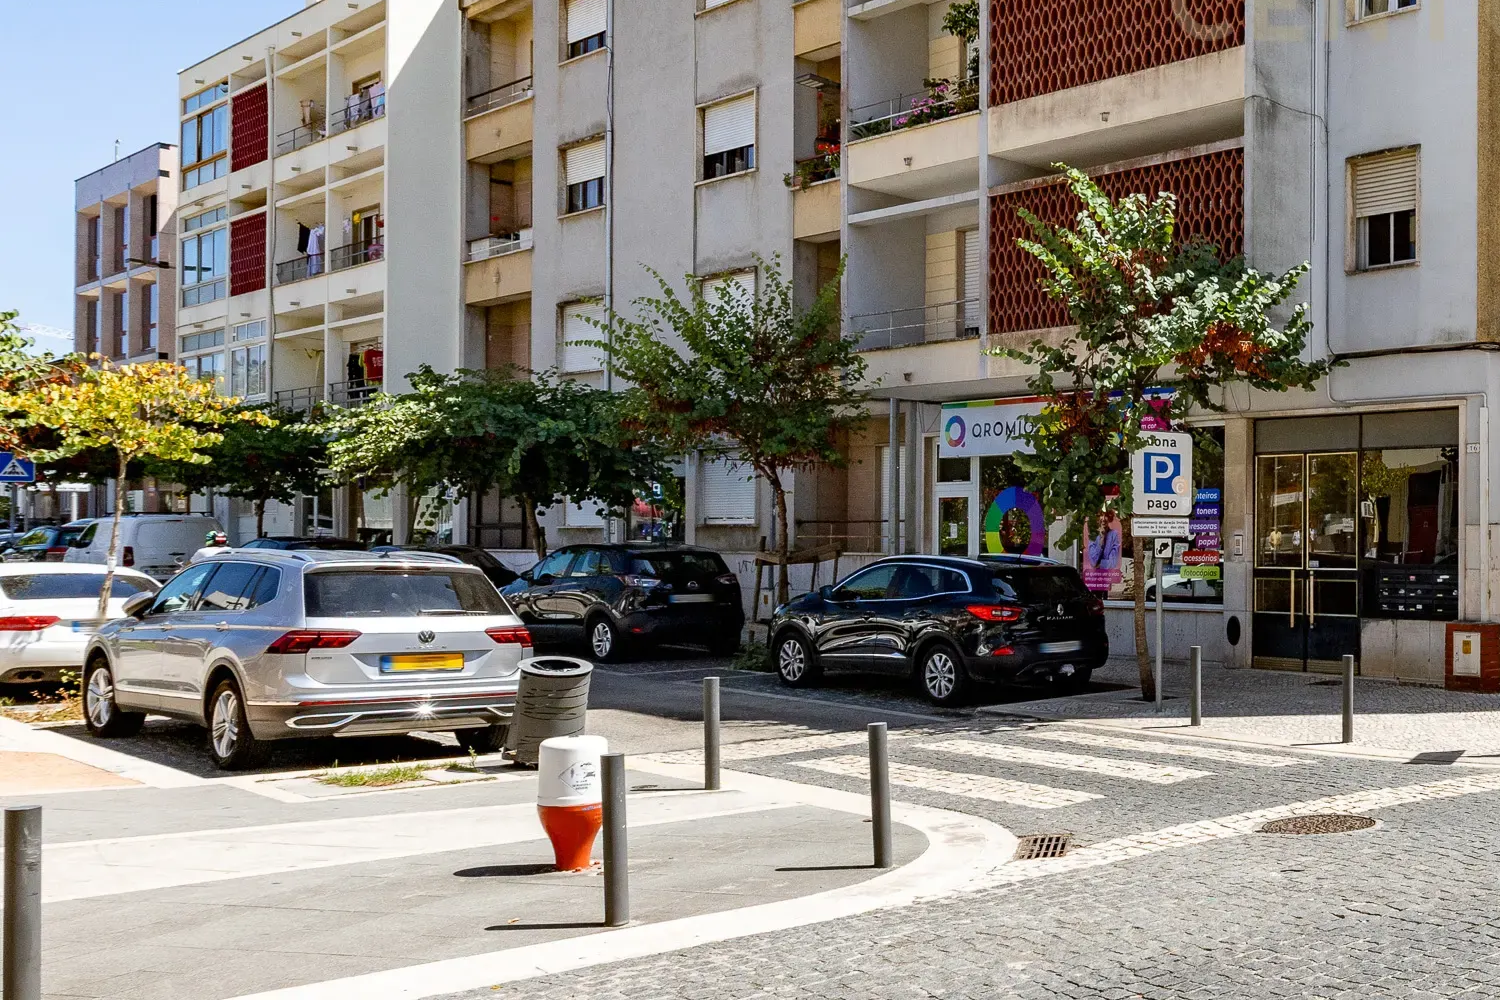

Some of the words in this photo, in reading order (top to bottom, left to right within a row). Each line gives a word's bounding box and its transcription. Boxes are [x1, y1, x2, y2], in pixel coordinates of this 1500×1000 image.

[1150, 455, 1174, 491] P
[1196, 492, 1218, 500] nteiros
[1147, 500, 1177, 511] pago
[1196, 507, 1218, 515] toners
[1198, 538, 1218, 547] papel
[1183, 553, 1218, 562] acessórios
[1183, 568, 1217, 577] fotocópias
